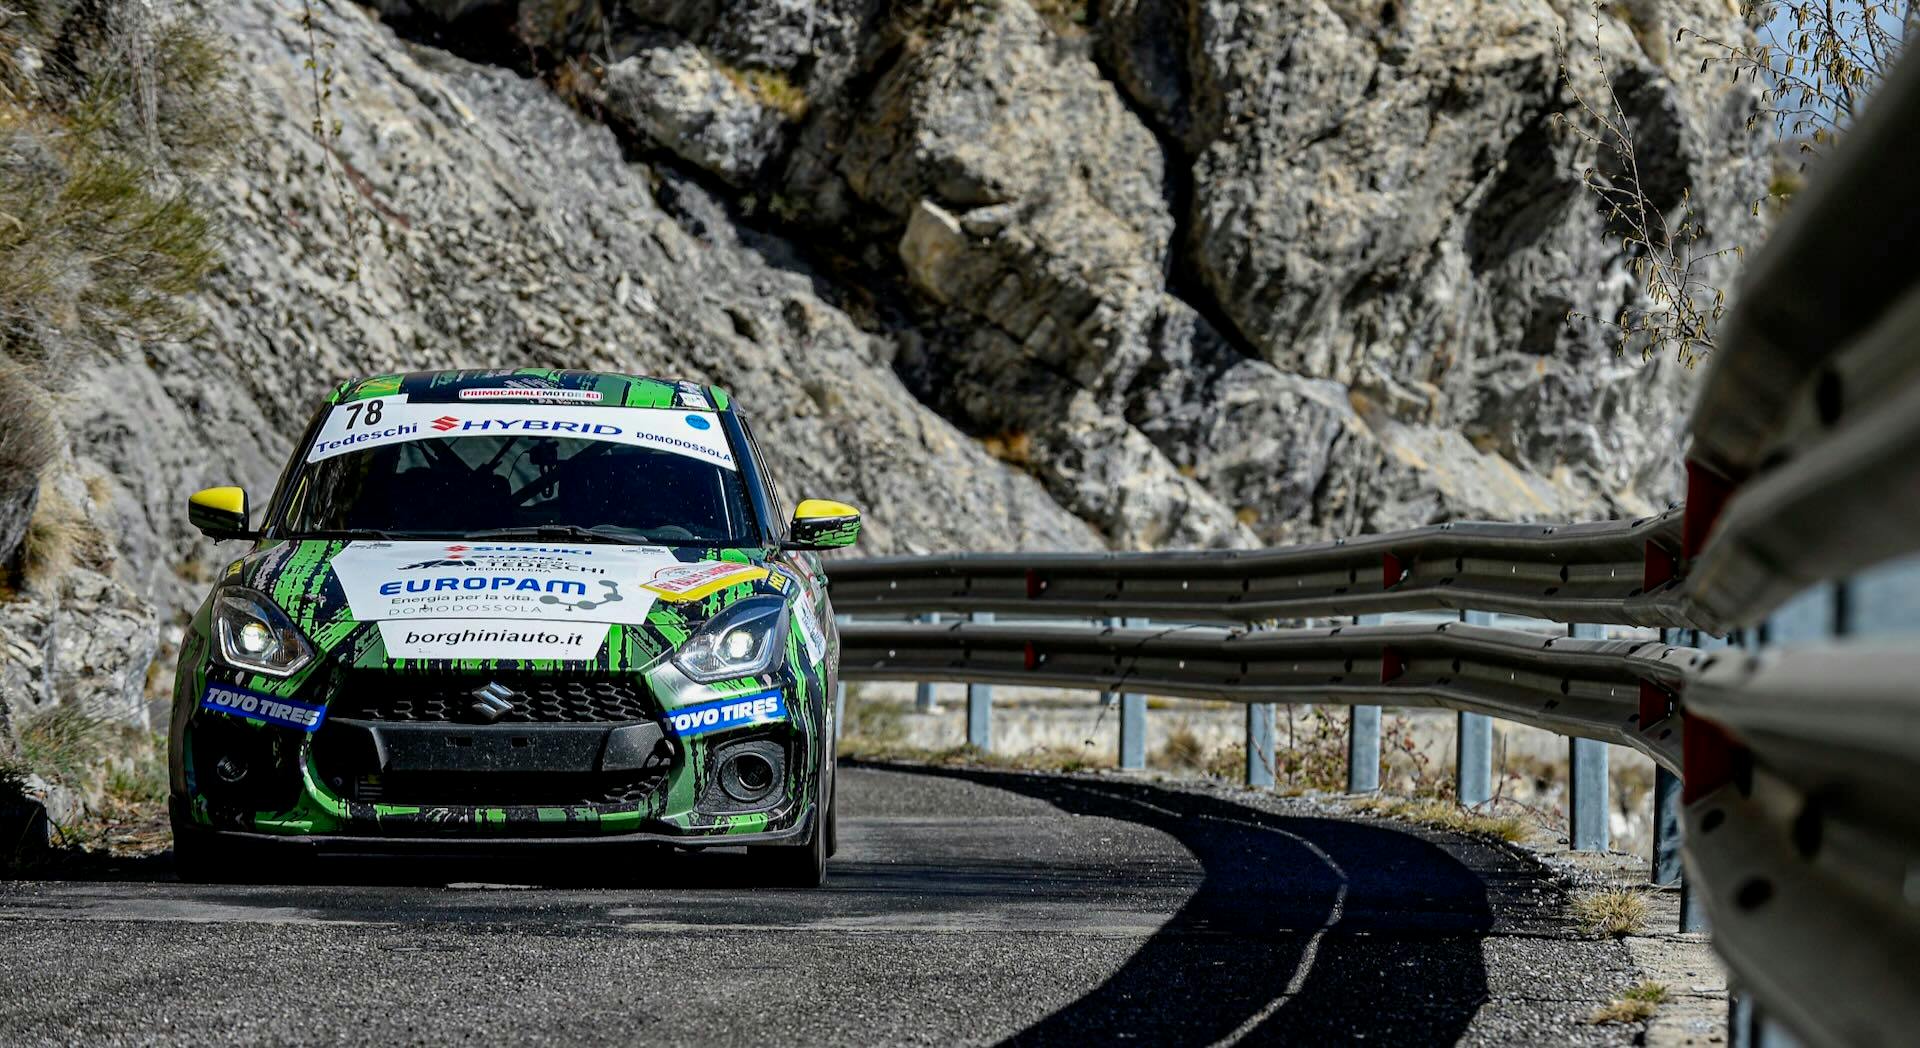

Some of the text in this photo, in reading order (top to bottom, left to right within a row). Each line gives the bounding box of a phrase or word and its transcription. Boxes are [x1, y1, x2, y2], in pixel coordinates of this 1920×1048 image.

[346, 399, 384, 431] 78
[462, 419, 623, 435] HYBRID
[316, 422, 418, 453] Tedeschi
[636, 431, 731, 462] DOMODOSSOLA
[473, 546, 593, 556] SUZUKI
[490, 562, 605, 575] TEDESCHI
[391, 593, 535, 605] Energia per la vita.
[388, 604, 543, 616] DOMODOSSOLA
[405, 629, 584, 646] borghiniauto.it
[206, 687, 321, 727] TOYO TIRES
[720, 696, 778, 721] TIRES
